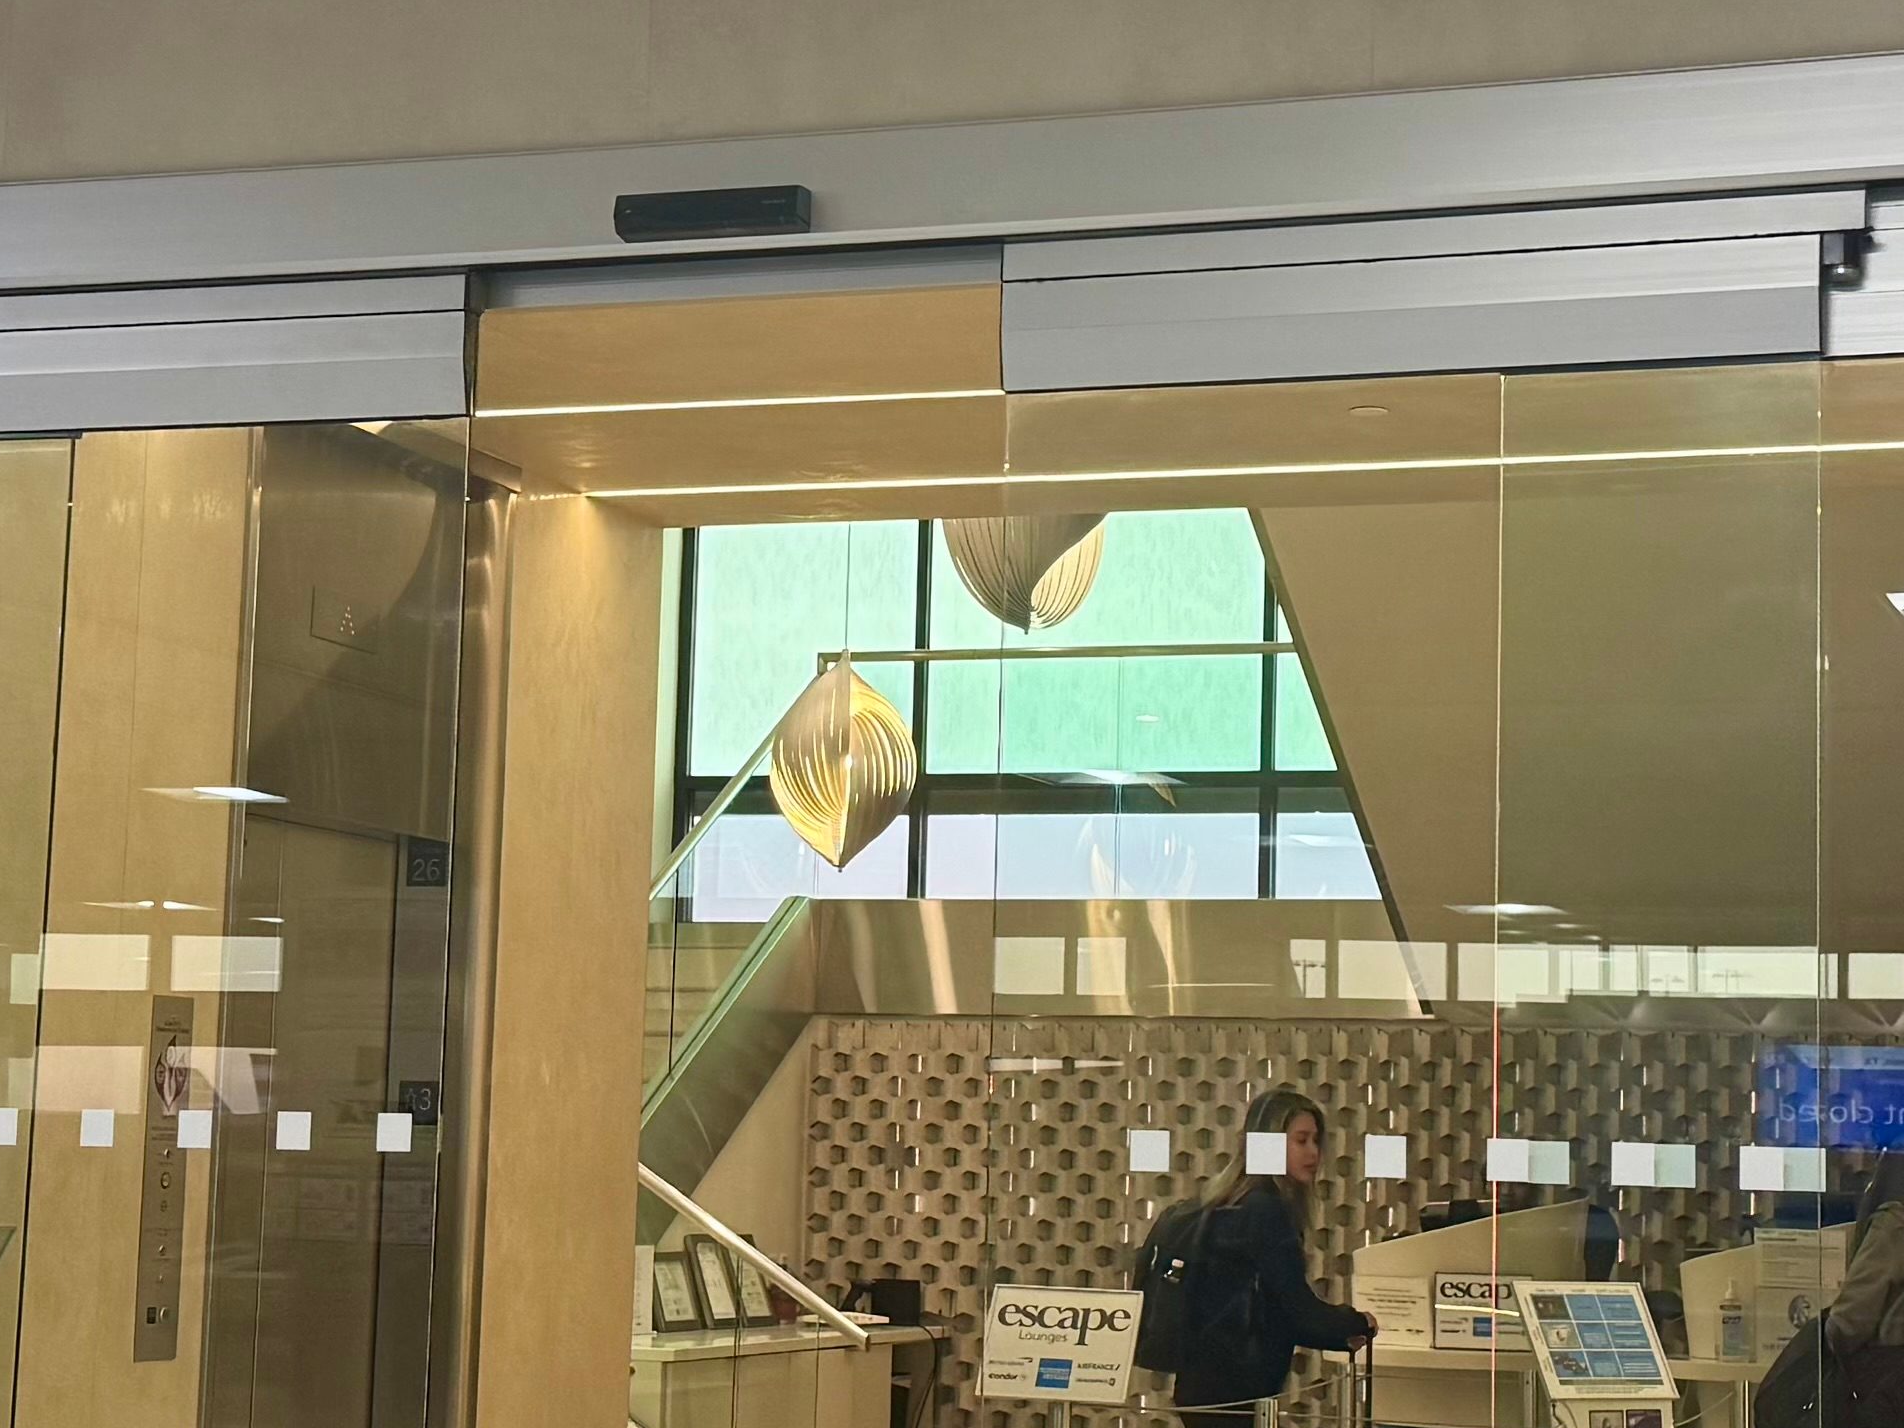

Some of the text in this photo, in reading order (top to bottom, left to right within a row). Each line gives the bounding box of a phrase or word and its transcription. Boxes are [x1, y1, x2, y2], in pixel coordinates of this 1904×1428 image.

[412, 859, 440, 881] 26
[998, 1303, 1131, 1346] escape
[1018, 1329, 1068, 1344] Lounges
